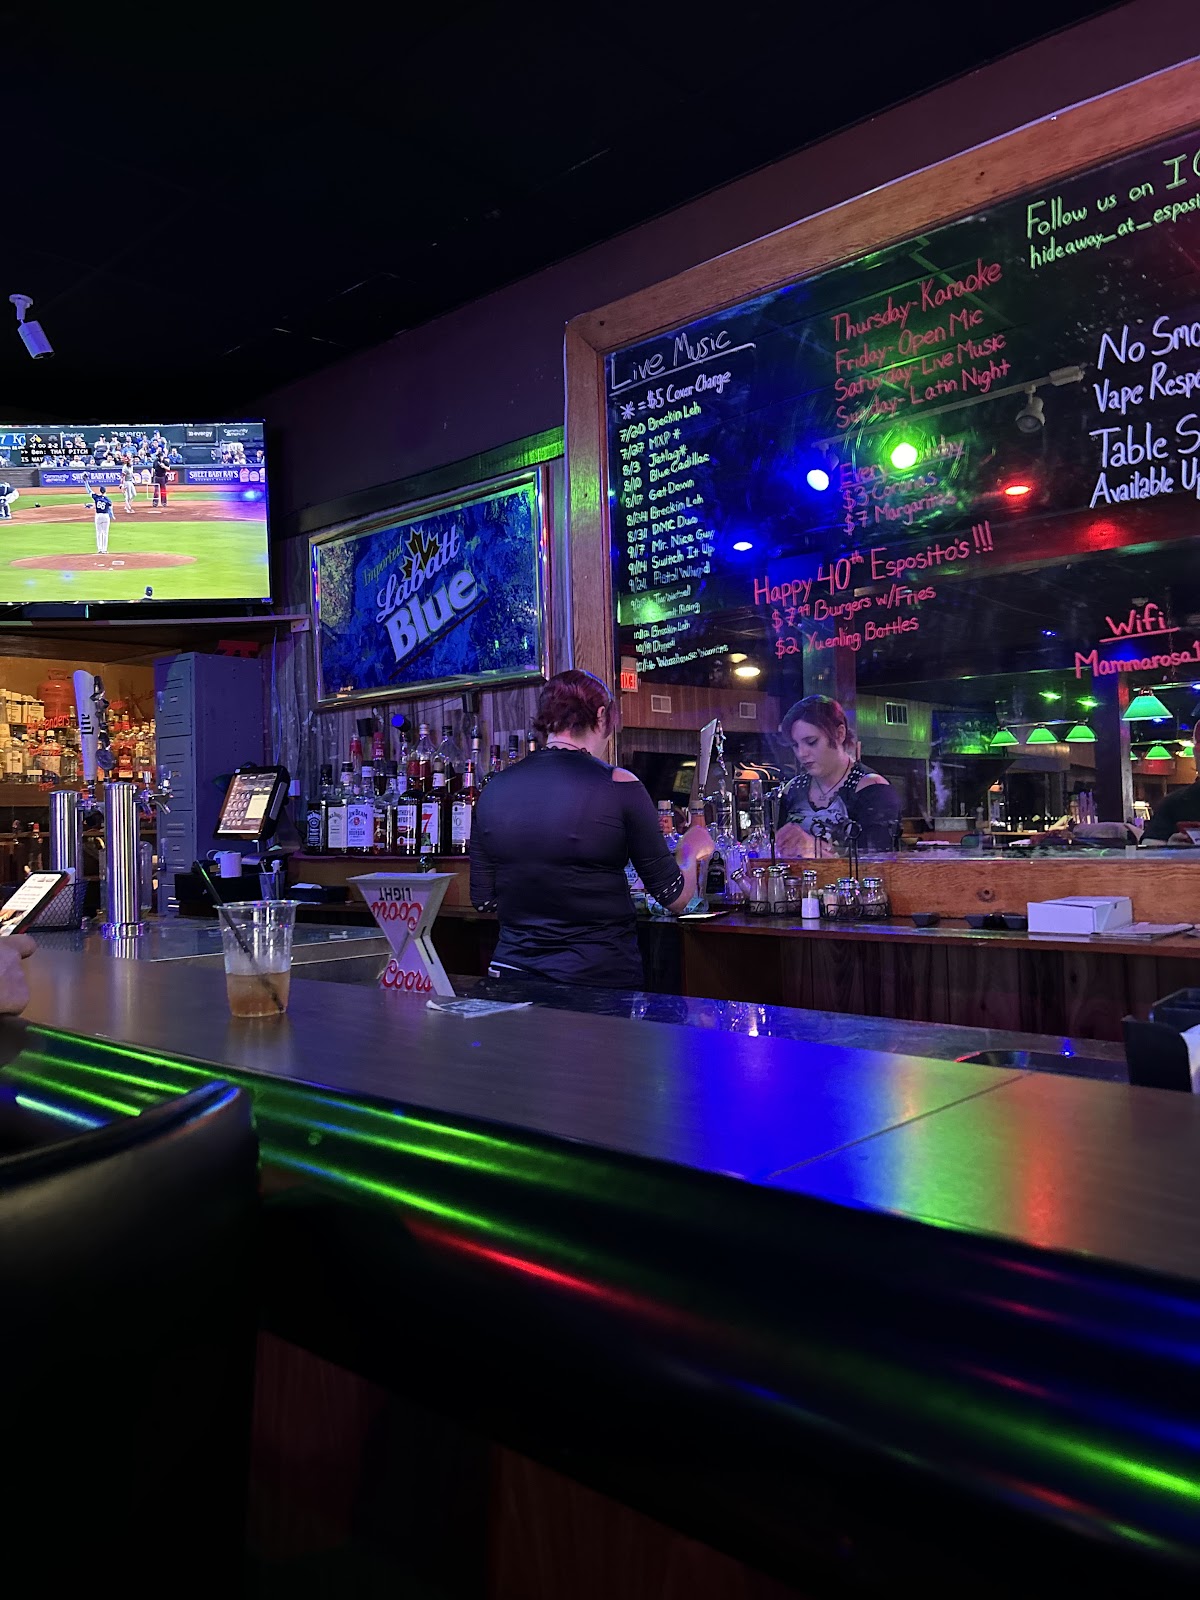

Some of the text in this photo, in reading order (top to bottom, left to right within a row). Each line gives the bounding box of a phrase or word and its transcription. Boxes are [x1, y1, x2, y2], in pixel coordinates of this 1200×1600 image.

[1026, 196, 1087, 239] Follow
[1097, 194, 1117, 212] us
[1129, 182, 1155, 202] on
[898, 326, 946, 356] Open
[949, 308, 984, 337] Mic
[1097, 324, 1145, 370] No
[611, 331, 731, 390] Live Music
[957, 333, 1006, 365] Music
[666, 384, 695, 403] Cover
[695, 371, 732, 394] Charge
[909, 378, 958, 405] Latin
[961, 358, 1011, 394] Night
[1093, 378, 1144, 415] Vape
[13, 433, 26, 446] KC
[1088, 422, 1169, 469] Table
[649, 468, 671, 482] Blue
[670, 452, 710, 473] Cadillac
[648, 486, 667, 501] Get
[1089, 466, 1174, 509] Available
[677, 515, 698, 528] Duo
[843, 510, 869, 536] $7
[627, 528, 715, 559] 9/7 Mr. Nice Guy
[651, 549, 685, 569] Switch
[686, 545, 700, 559] It
[701, 542, 715, 557] Up
[362, 536, 403, 587] Imported
[376, 524, 460, 623] Labatt
[753, 575, 812, 607] Happy
[384, 569, 478, 663] Blue
[814, 595, 872, 621] Burgers
[1105, 603, 1167, 636] Wifi
[775, 636, 800, 659] $2
[864, 616, 920, 643] Bottles
[421, 813, 433, 833] 7
[378, 887, 413, 901] LIGHT
[370, 901, 423, 931] Coors
[381, 959, 433, 992] Coors
